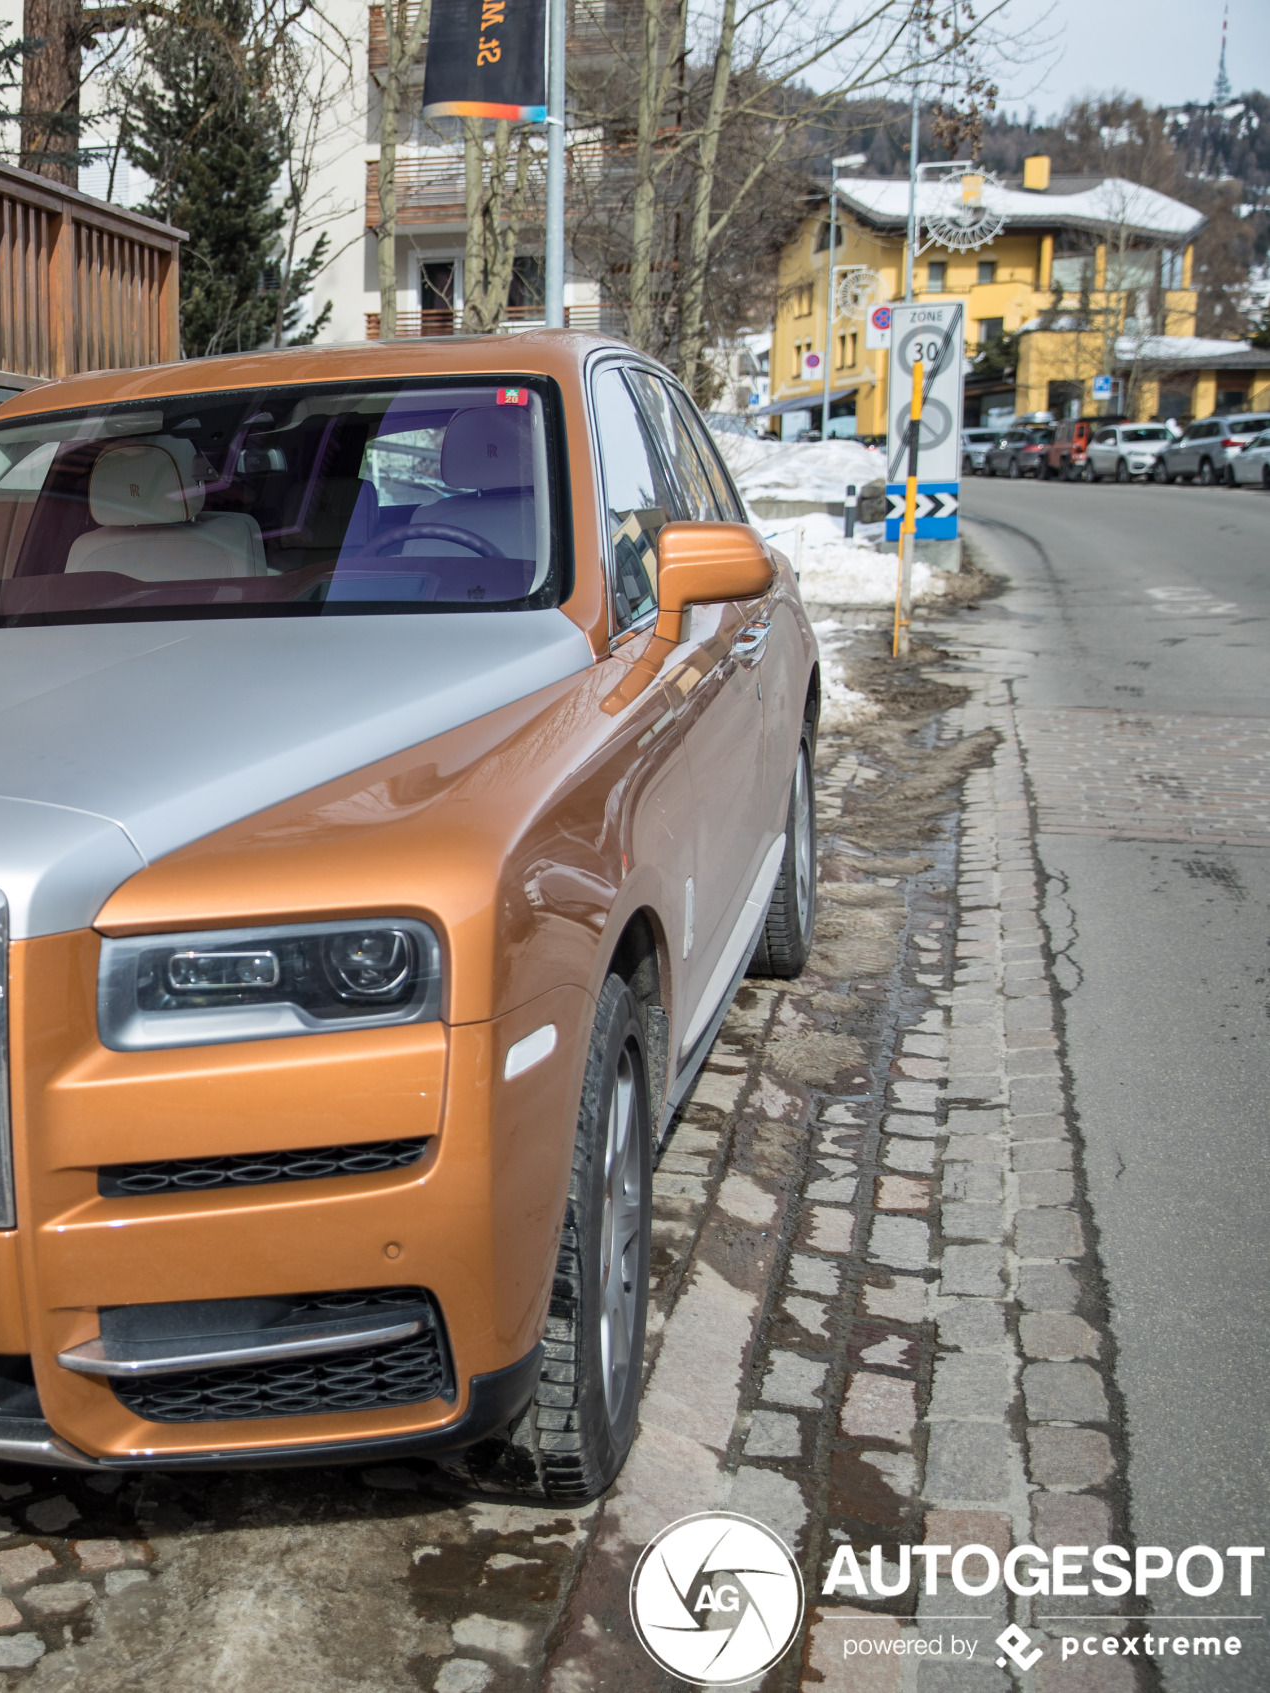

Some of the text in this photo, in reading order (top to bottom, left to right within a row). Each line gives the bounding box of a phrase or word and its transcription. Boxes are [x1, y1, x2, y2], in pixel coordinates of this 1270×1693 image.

[910, 311, 943, 323] ZONE
[914, 342, 938, 362] 30
[504, 396, 519, 404] 20
